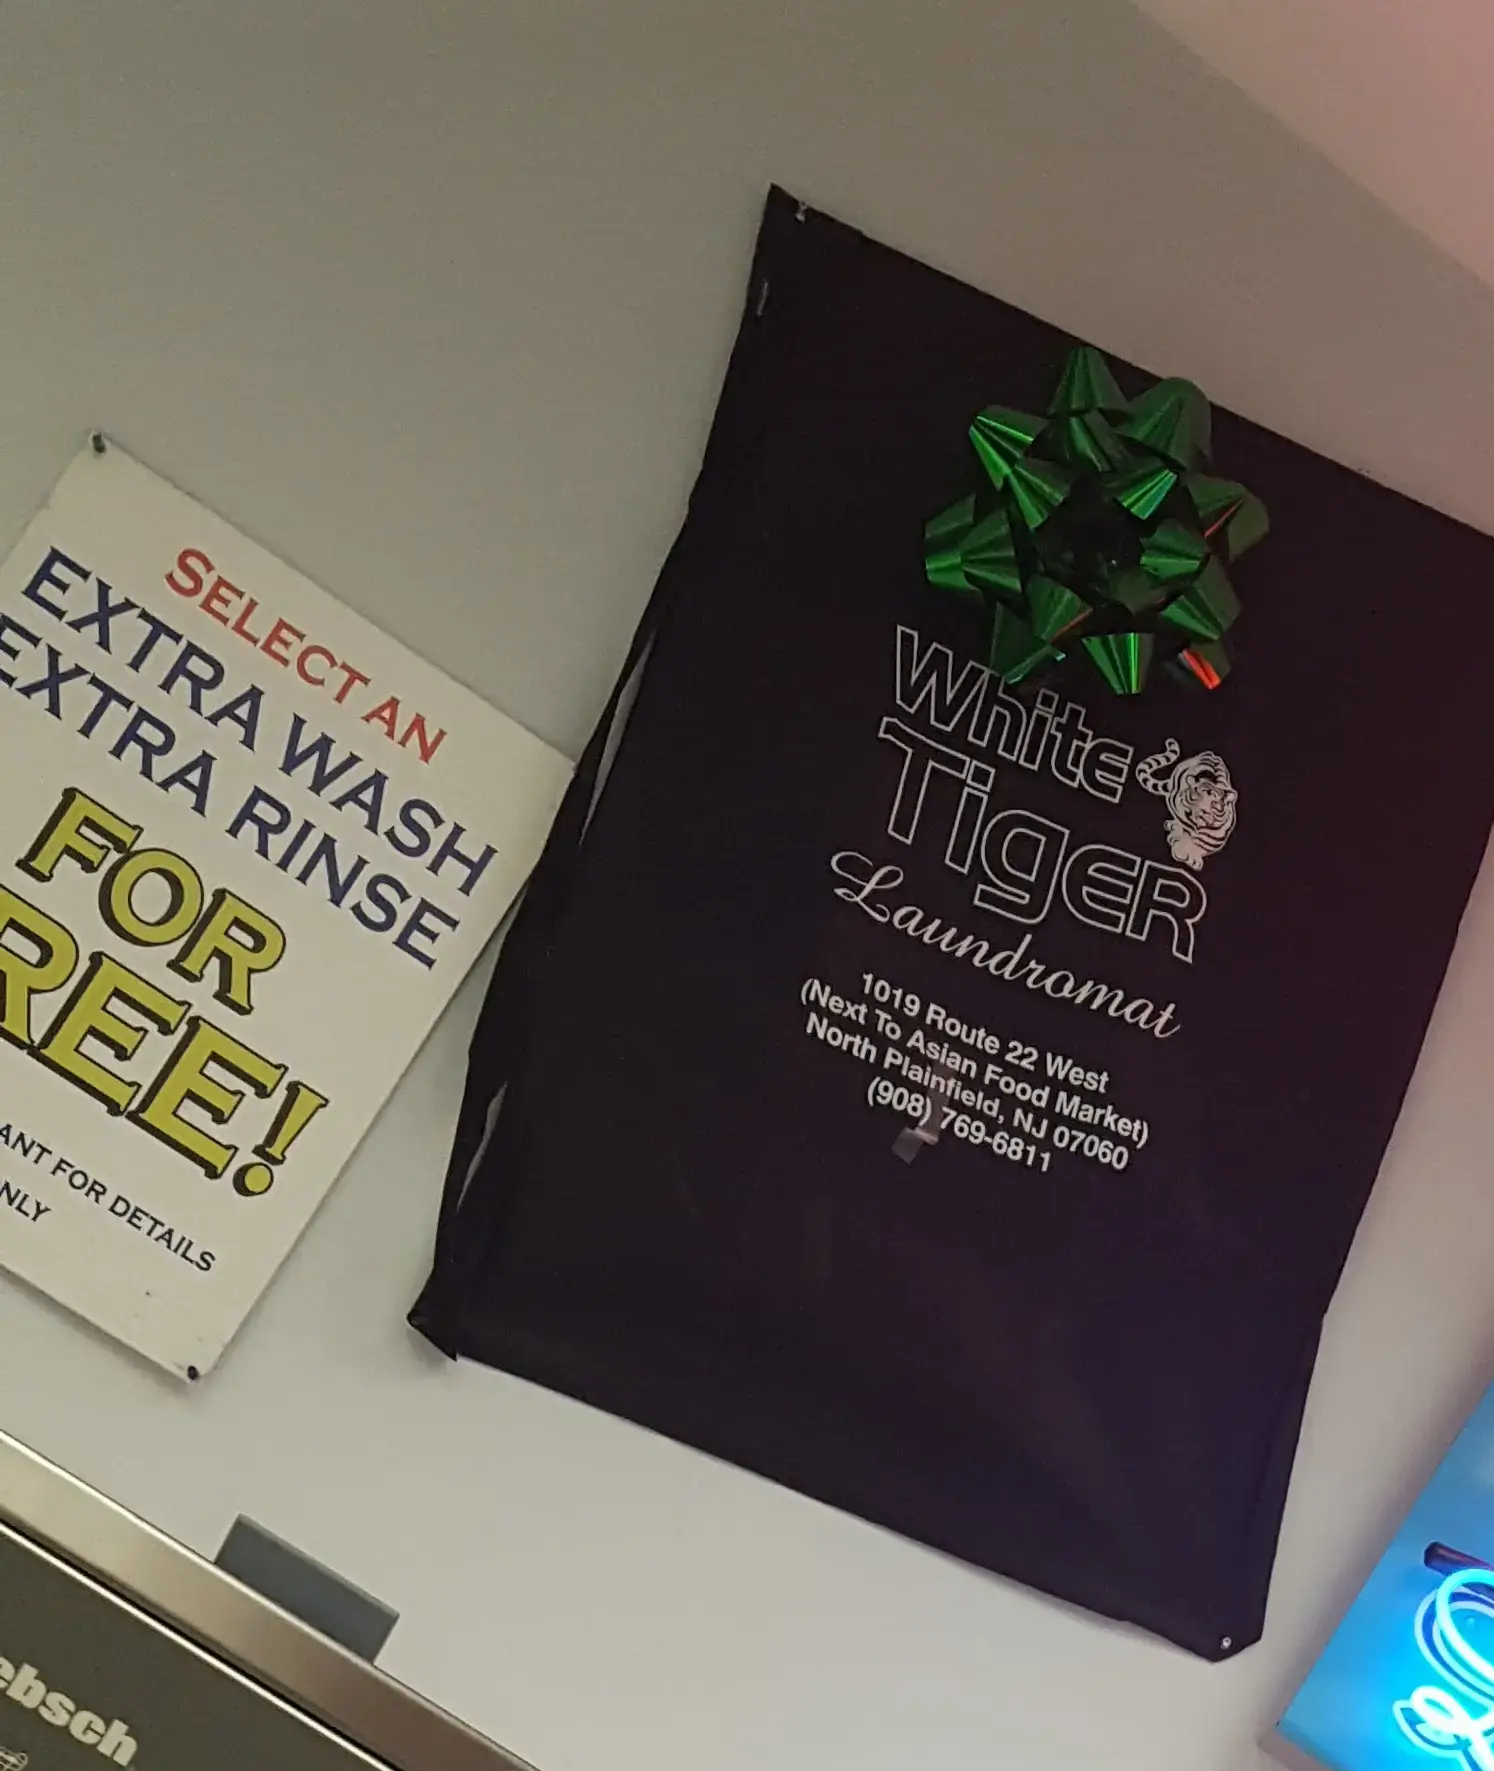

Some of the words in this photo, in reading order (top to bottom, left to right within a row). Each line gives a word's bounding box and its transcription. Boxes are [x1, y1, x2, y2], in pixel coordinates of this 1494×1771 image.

[20, 545, 266, 752] EXTRA
[281, 714, 498, 897] WASH
[164, 547, 370, 706] SELECT
[362, 696, 447, 766] AN
[895, 625, 1133, 804] White
[0, 613, 218, 819] EXTRA
[225, 784, 459, 971] RINSE
[17, 787, 288, 1016] FOR
[830, 851, 1180, 1038] Laundromat
[0, 885, 328, 1198] REE!
[801, 977, 868, 1026] (Next
[875, 1008, 902, 1040] To
[906, 1029, 977, 1079] Asian
[983, 1064, 1048, 1109] Food
[1055, 1094, 1149, 1148] Market)
[806, 1011, 880, 1067] North
[883, 1050, 1004, 1126] Plainfield,
[1012, 1108, 1047, 1139] NJ
[1053, 1123, 1128, 1170] 07060
[862, 973, 920, 1017] 1019
[925, 1002, 1000, 1056] Route
[1005, 1041, 1038, 1072] 22
[1046, 1053, 1109, 1093] West
[0, 1123, 52, 1166] ANT
[51, 1157, 107, 1204] FOR
[108, 1195, 216, 1273] DETAILS
[0, 1178, 51, 1224] NLY
[867, 1076, 933, 1127] (908)
[939, 1107, 1050, 1172] 769-6811
